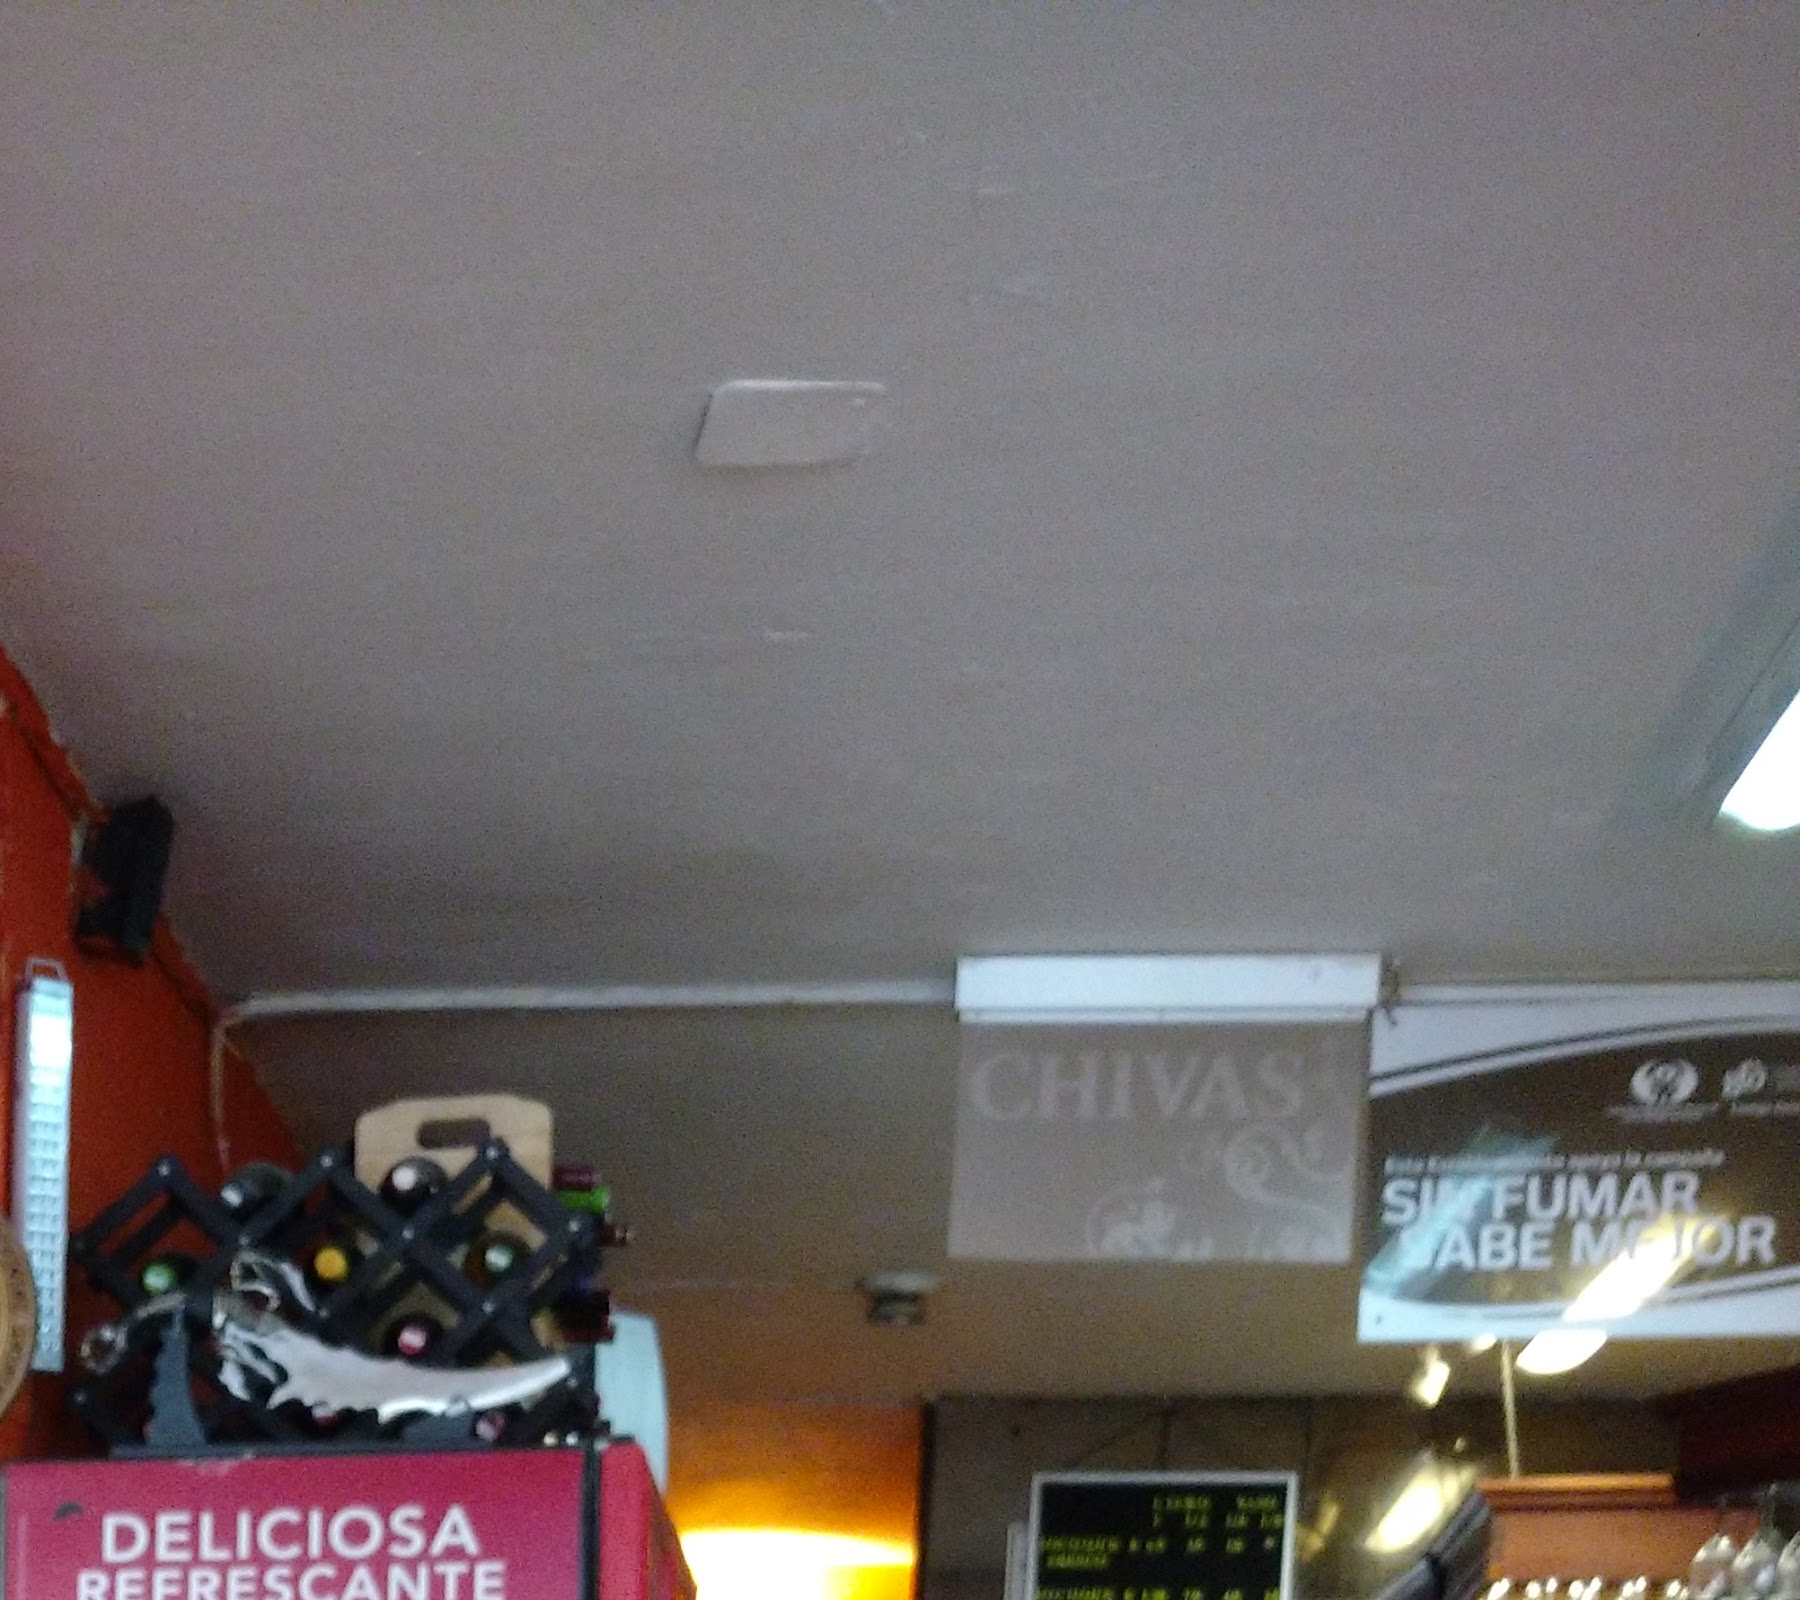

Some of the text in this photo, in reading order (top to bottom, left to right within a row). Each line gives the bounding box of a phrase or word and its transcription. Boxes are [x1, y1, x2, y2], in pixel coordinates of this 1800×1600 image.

[973, 1047, 1306, 1121] CHIVAS
[1492, 1170, 1700, 1222] FUMAR
[101, 1504, 480, 1564] DELICIOSA
